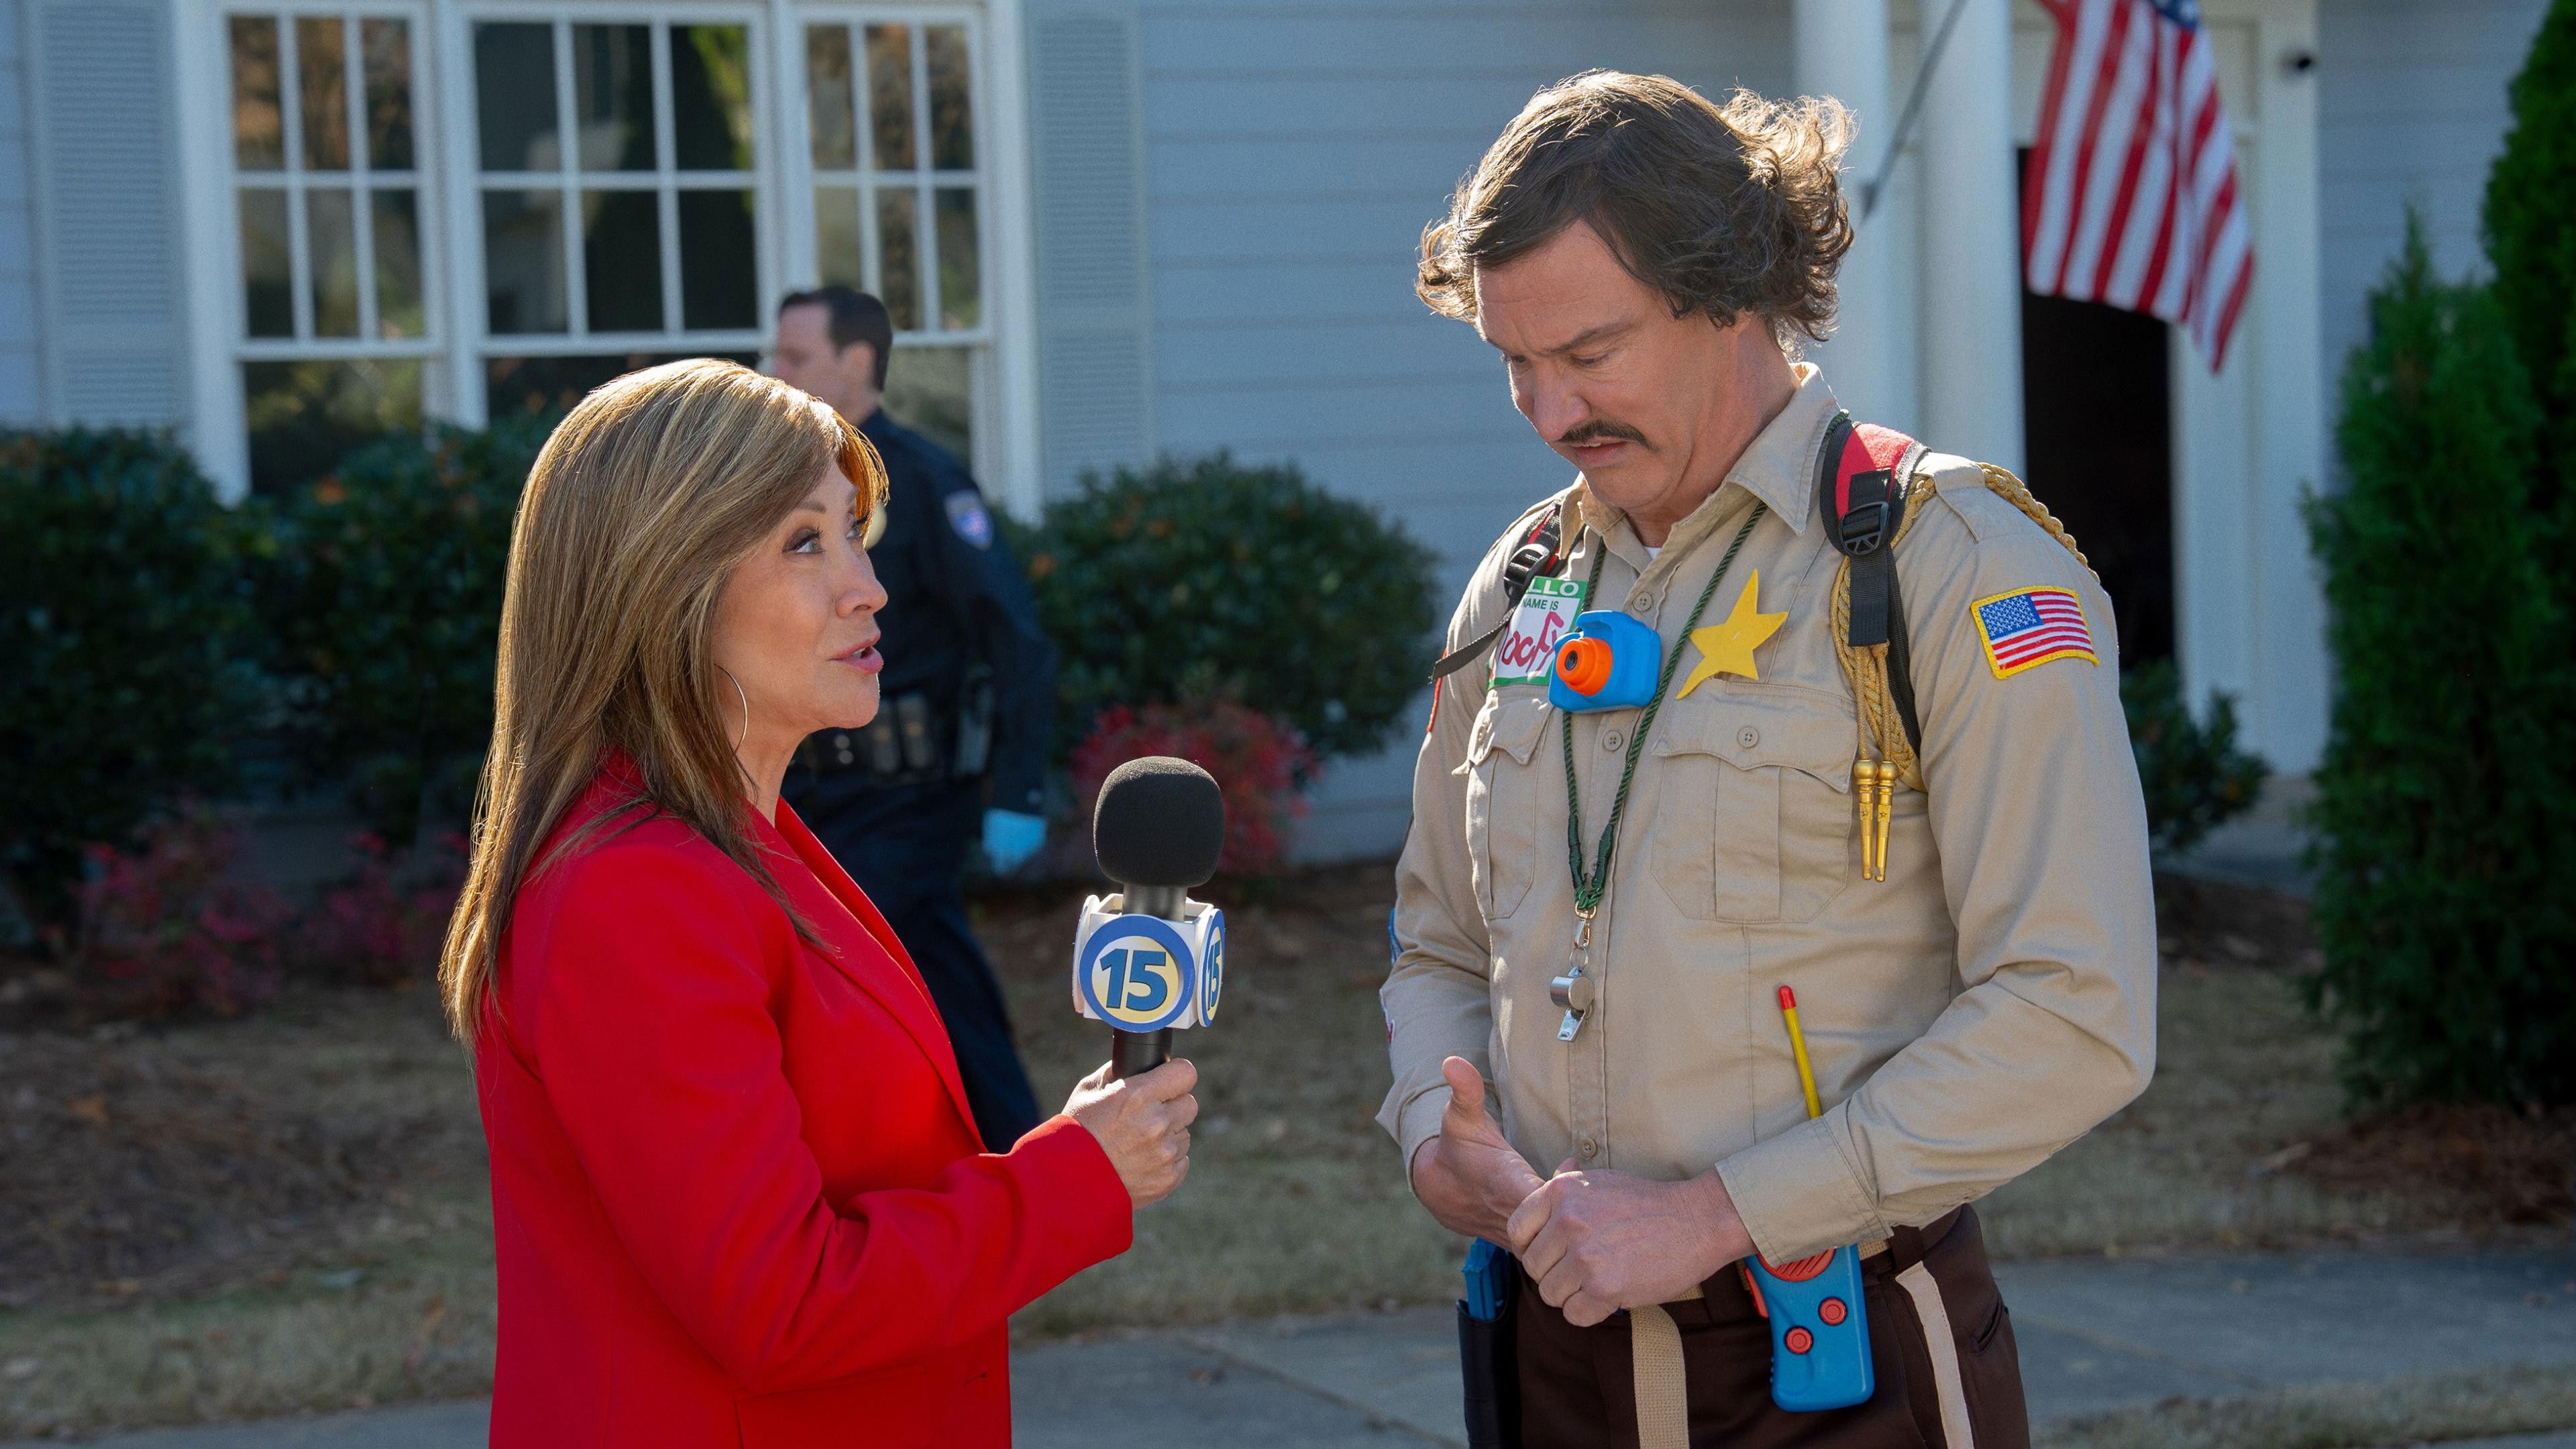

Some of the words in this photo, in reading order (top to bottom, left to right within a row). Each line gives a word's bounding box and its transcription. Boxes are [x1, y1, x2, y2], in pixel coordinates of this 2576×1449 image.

[1522, 598, 1548, 610] NAME
[1550, 600, 1559, 610] IS
[1529, 580, 1579, 596] LLO
[1100, 948, 1168, 1012] 15
[1208, 939, 1221, 1011] 15
